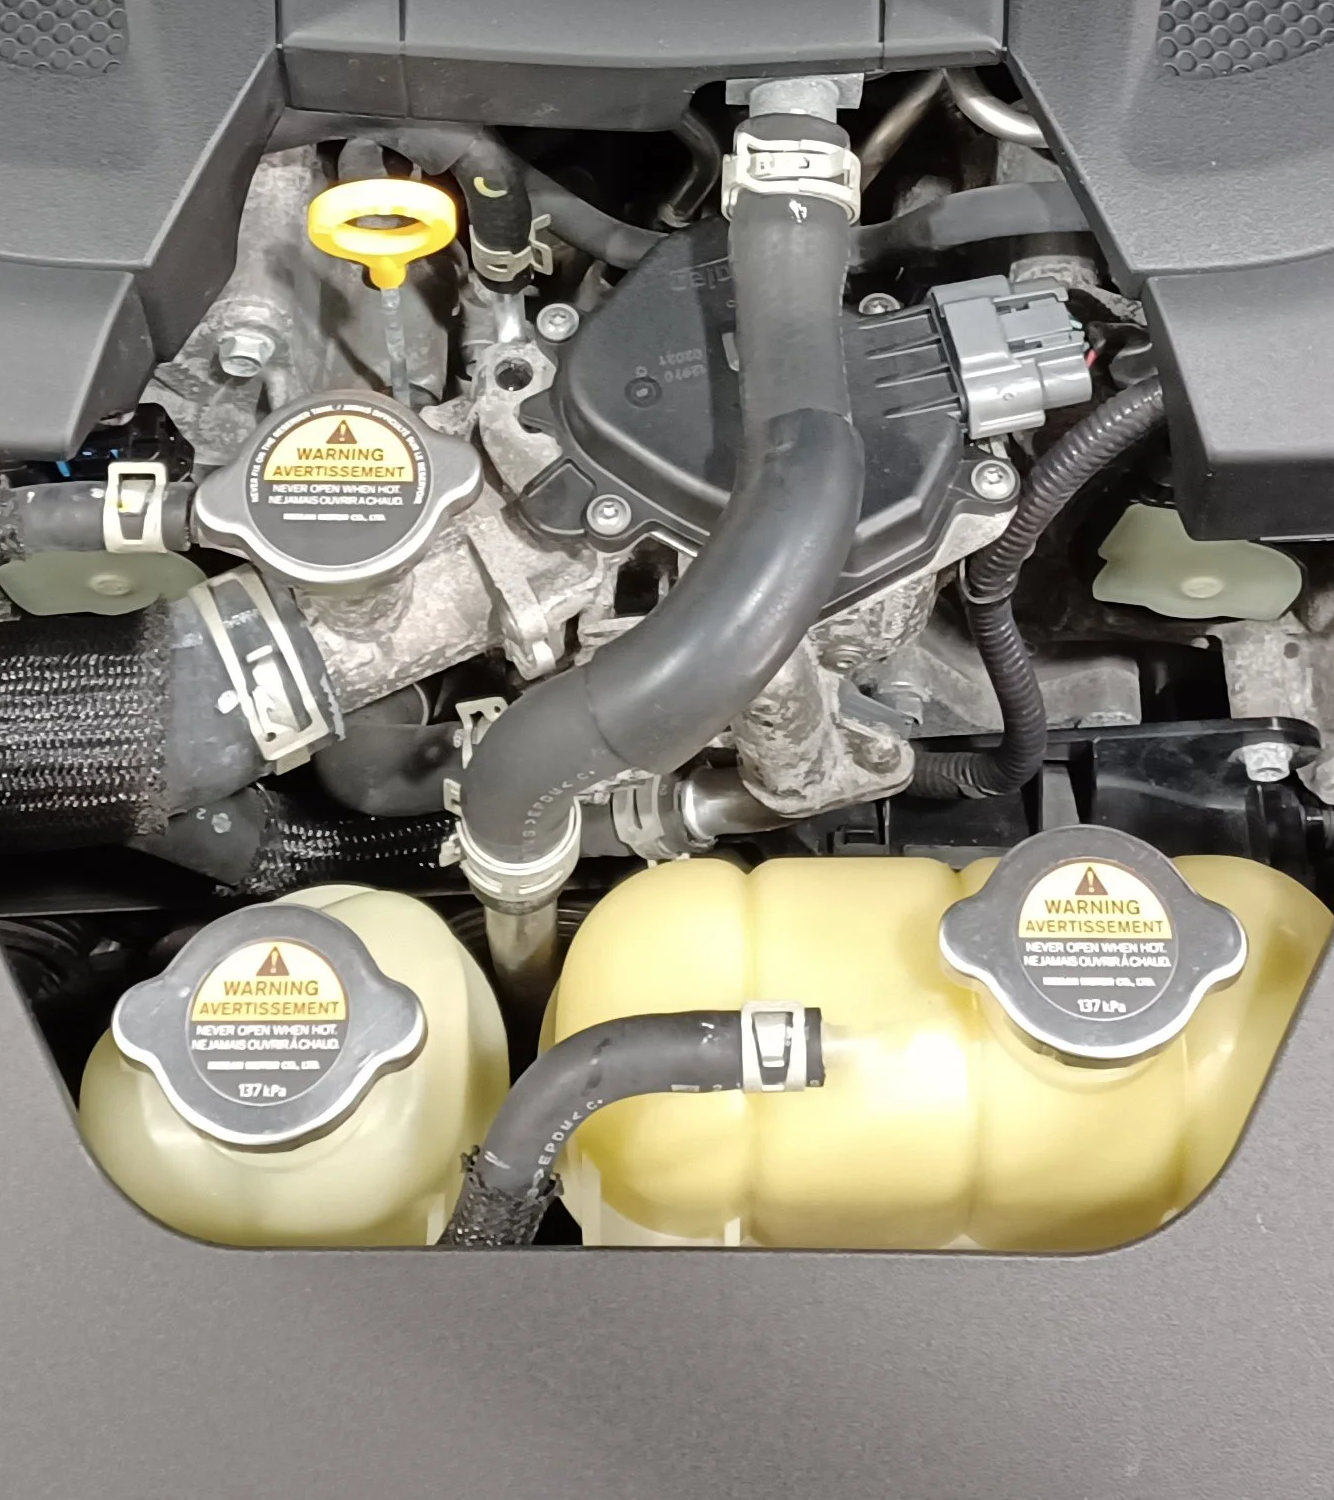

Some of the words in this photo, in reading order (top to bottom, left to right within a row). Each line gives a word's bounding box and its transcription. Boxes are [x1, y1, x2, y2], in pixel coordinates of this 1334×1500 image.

[296, 448, 384, 462] WARNING
[272, 465, 406, 479] AVERTISSEMENT
[272, 484, 308, 493] NEVER
[309, 484, 340, 494] OPEN
[342, 484, 376, 494] WHEN
[1043, 900, 1140, 915] WARNING
[1025, 920, 1164, 934] AVERTISSEMENT
[1025, 942, 1064, 952] NEVER
[1066, 942, 1100, 953] OPEN
[1100, 942, 1139, 953] WHEN
[224, 980, 319, 996] WARNING
[199, 1001, 339, 1016] AVERTISSEMENT
[1077, 999, 1101, 1013] 137
[196, 1024, 235, 1036] NEVER
[237, 1024, 270, 1036] OPEN
[272, 1024, 309, 1036] WHEN
[238, 1083, 263, 1098] 137
[263, 1084, 287, 1098] kPa
